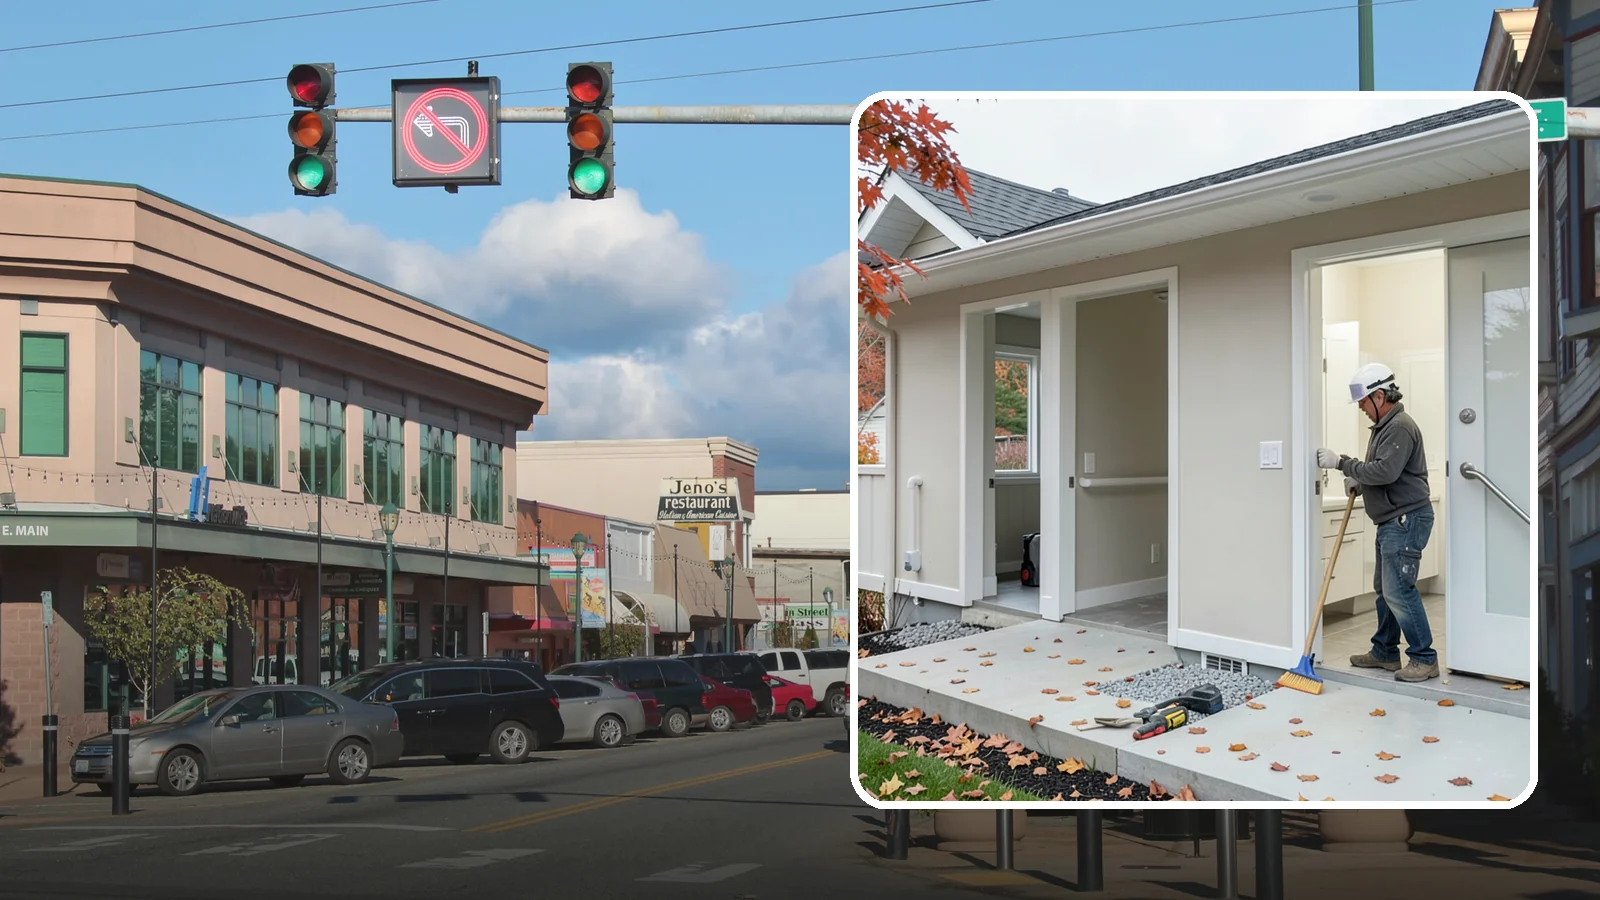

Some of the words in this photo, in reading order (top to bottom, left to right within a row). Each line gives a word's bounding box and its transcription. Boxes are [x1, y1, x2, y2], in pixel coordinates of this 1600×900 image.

[669, 480, 728, 495] Jeno's
[664, 496, 731, 509] restaurant
[658, 510, 682, 520] Italian
[686, 510, 715, 519] American
[715, 509, 738, 519] Cuisine
[2, 525, 13, 536] E.
[15, 525, 49, 536] MAIN
[797, 608, 828, 616] Street
